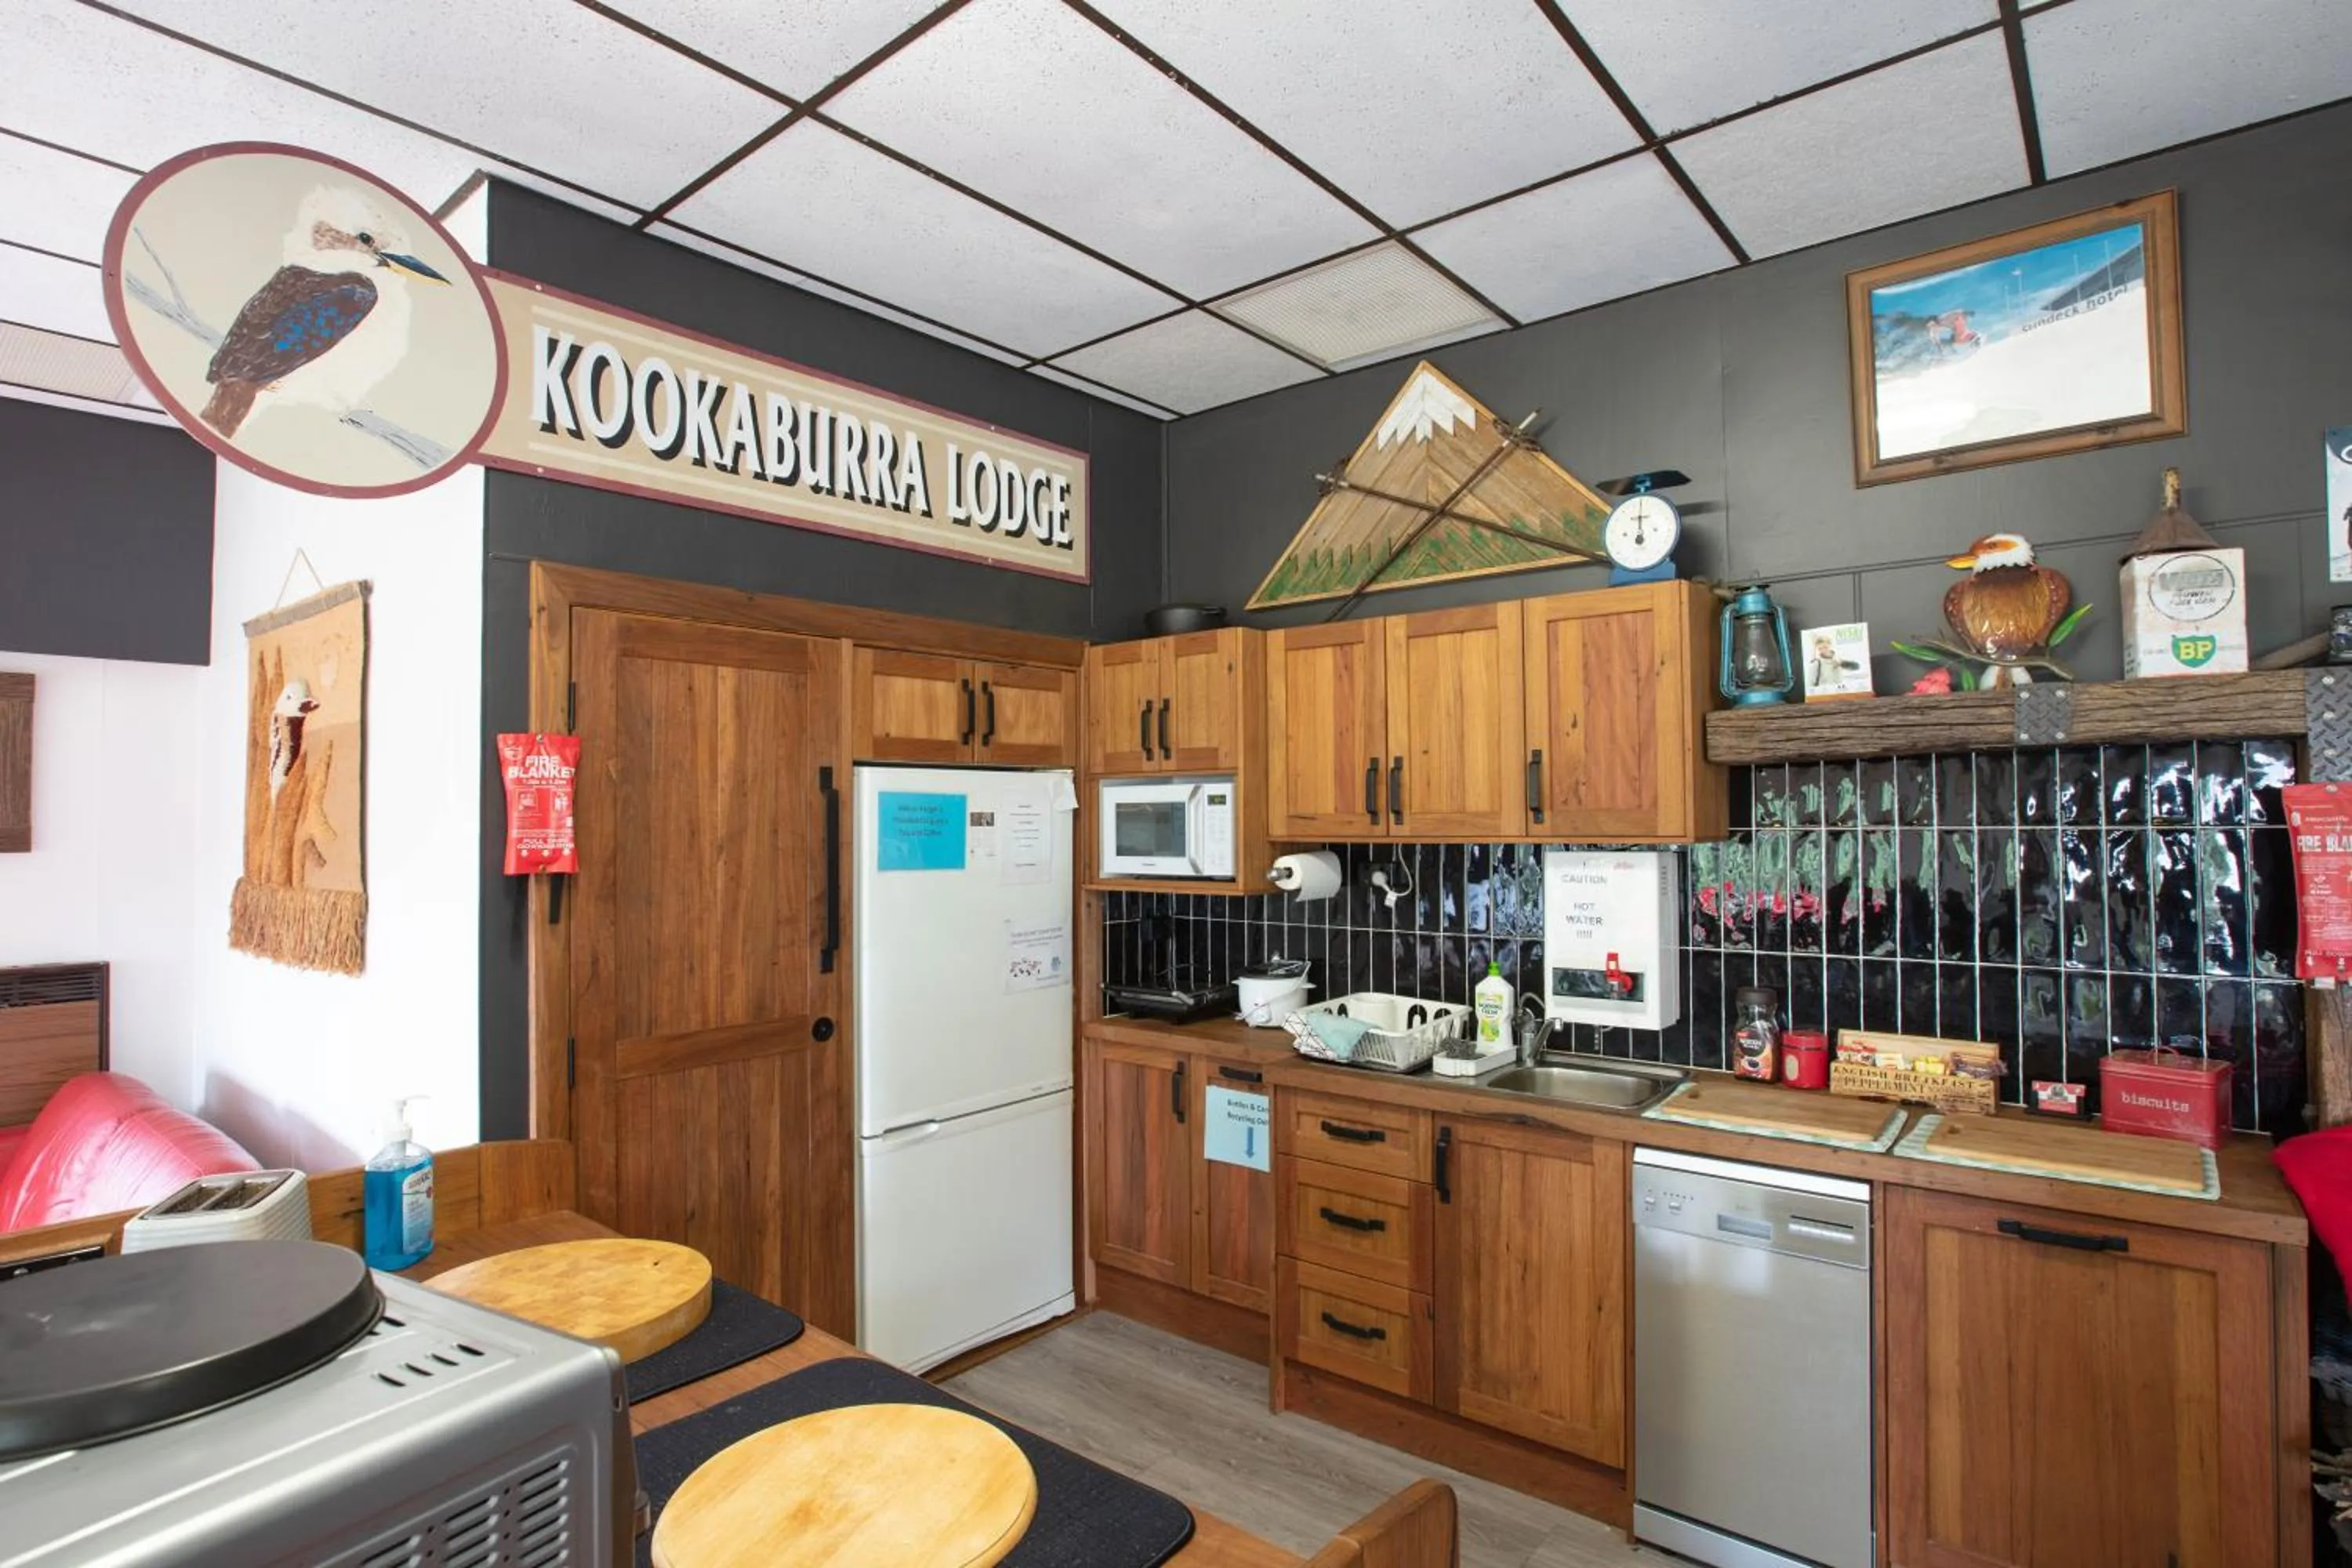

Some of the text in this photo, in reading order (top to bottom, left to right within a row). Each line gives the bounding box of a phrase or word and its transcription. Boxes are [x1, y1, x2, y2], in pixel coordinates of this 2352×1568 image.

[529, 324, 1074, 550] KOOKABURRA LODGE
[2180, 641, 2212, 659] BP
[524, 755, 561, 768] FIRE
[507, 765, 575, 779] BLANKET
[2296, 835, 2321, 852] FIRE
[1561, 873, 1608, 884] CAUTION
[1573, 902, 1595, 911] HOT
[1566, 915, 1604, 926] WATER
[1833, 1065, 1888, 1080] ENGLISH
[1843, 1076, 1926, 1094] PEPPERMINT
[2121, 1091, 2190, 1112] biscuits
